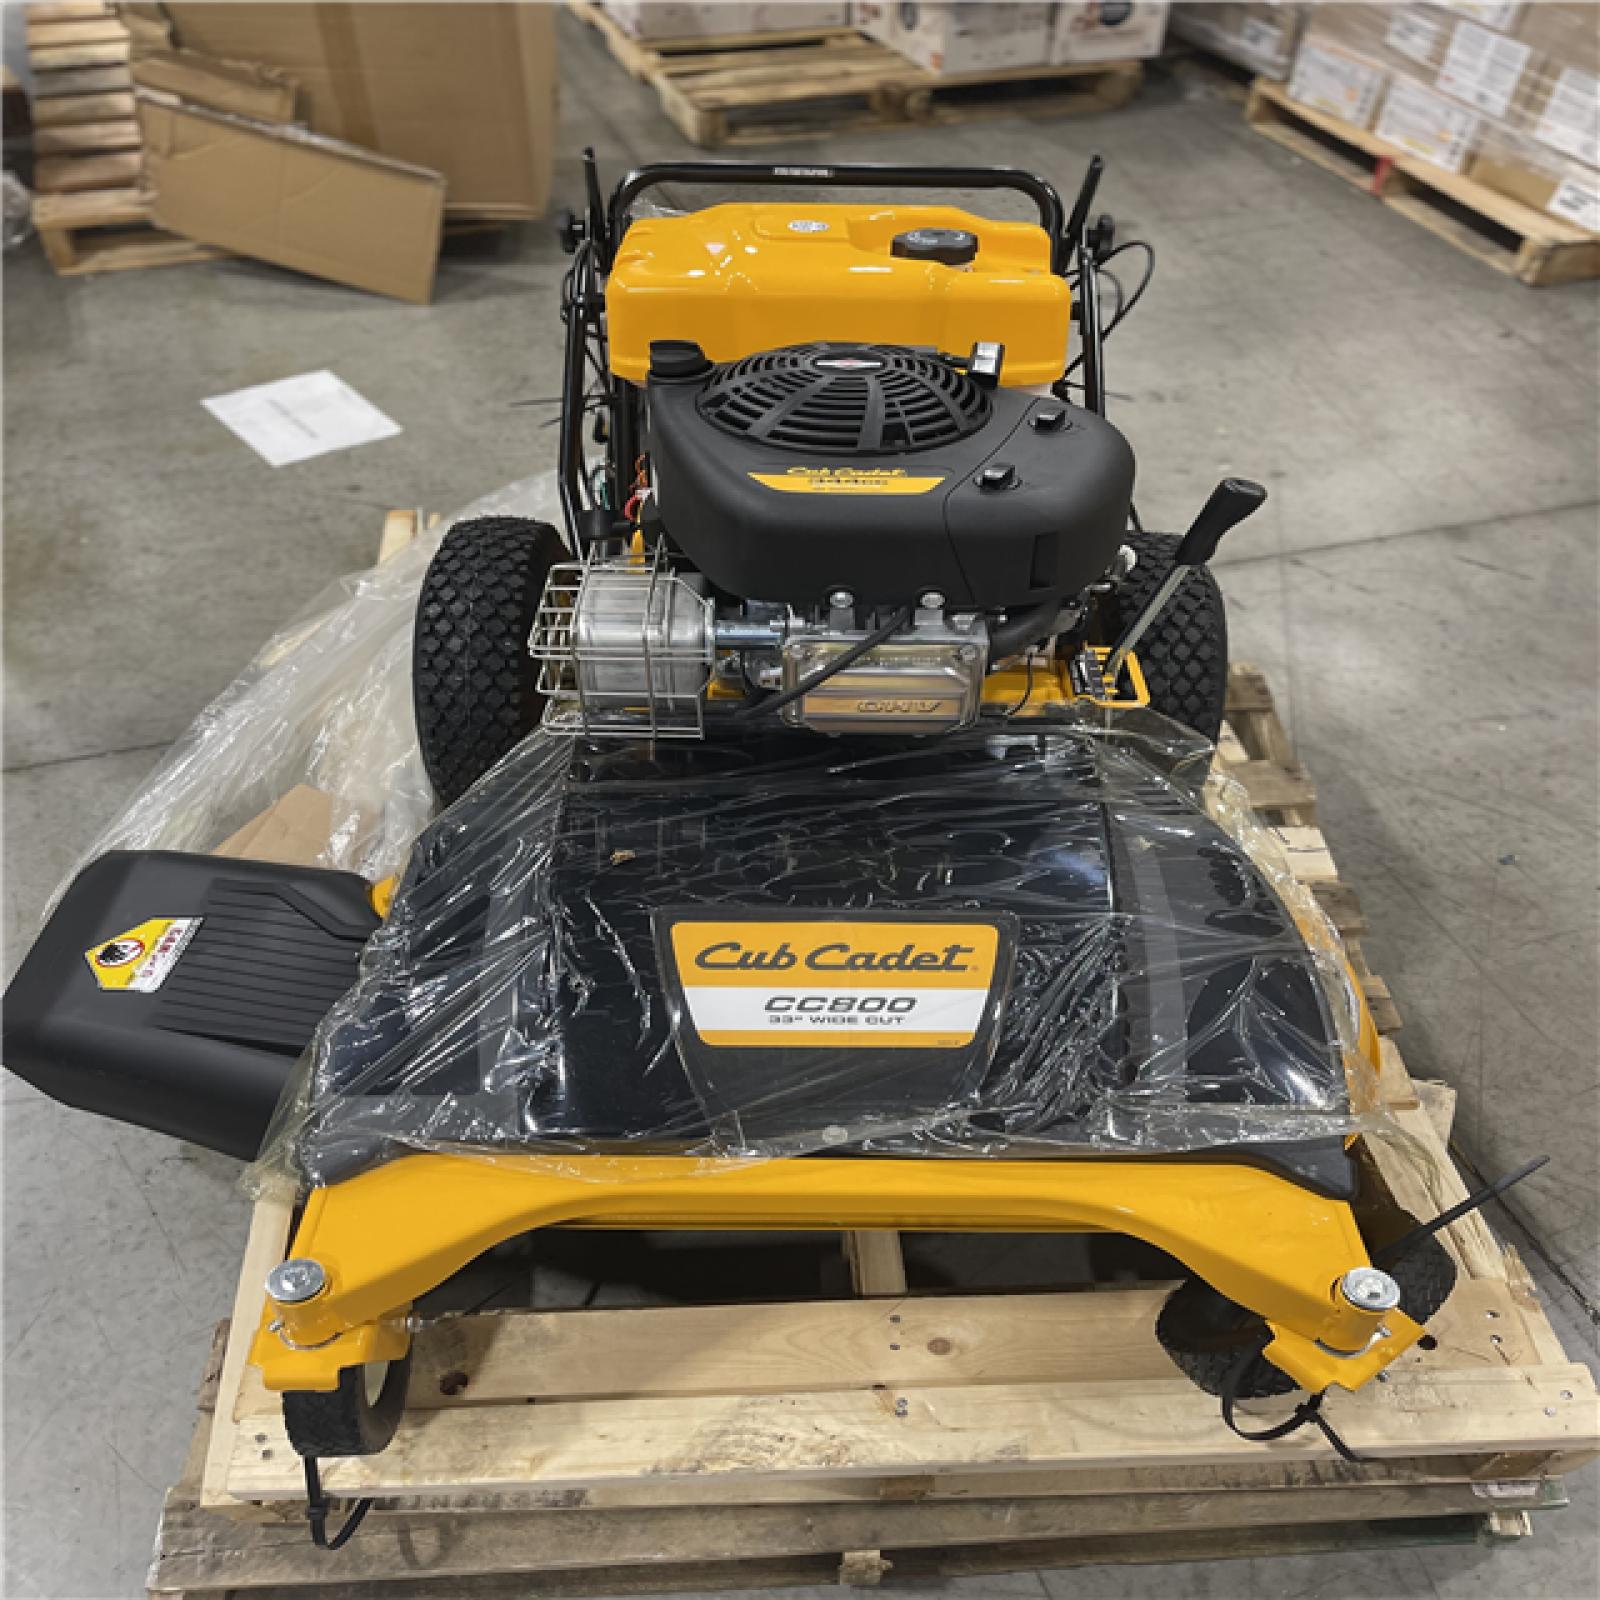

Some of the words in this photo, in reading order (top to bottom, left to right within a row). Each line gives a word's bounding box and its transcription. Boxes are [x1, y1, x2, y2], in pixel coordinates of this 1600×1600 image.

[694, 942, 798, 971] Cub
[804, 944, 975, 971] Cadet
[765, 996, 917, 1013] CC800
[809, 1015, 858, 1025] WIDE
[864, 1015, 906, 1025] CUT
